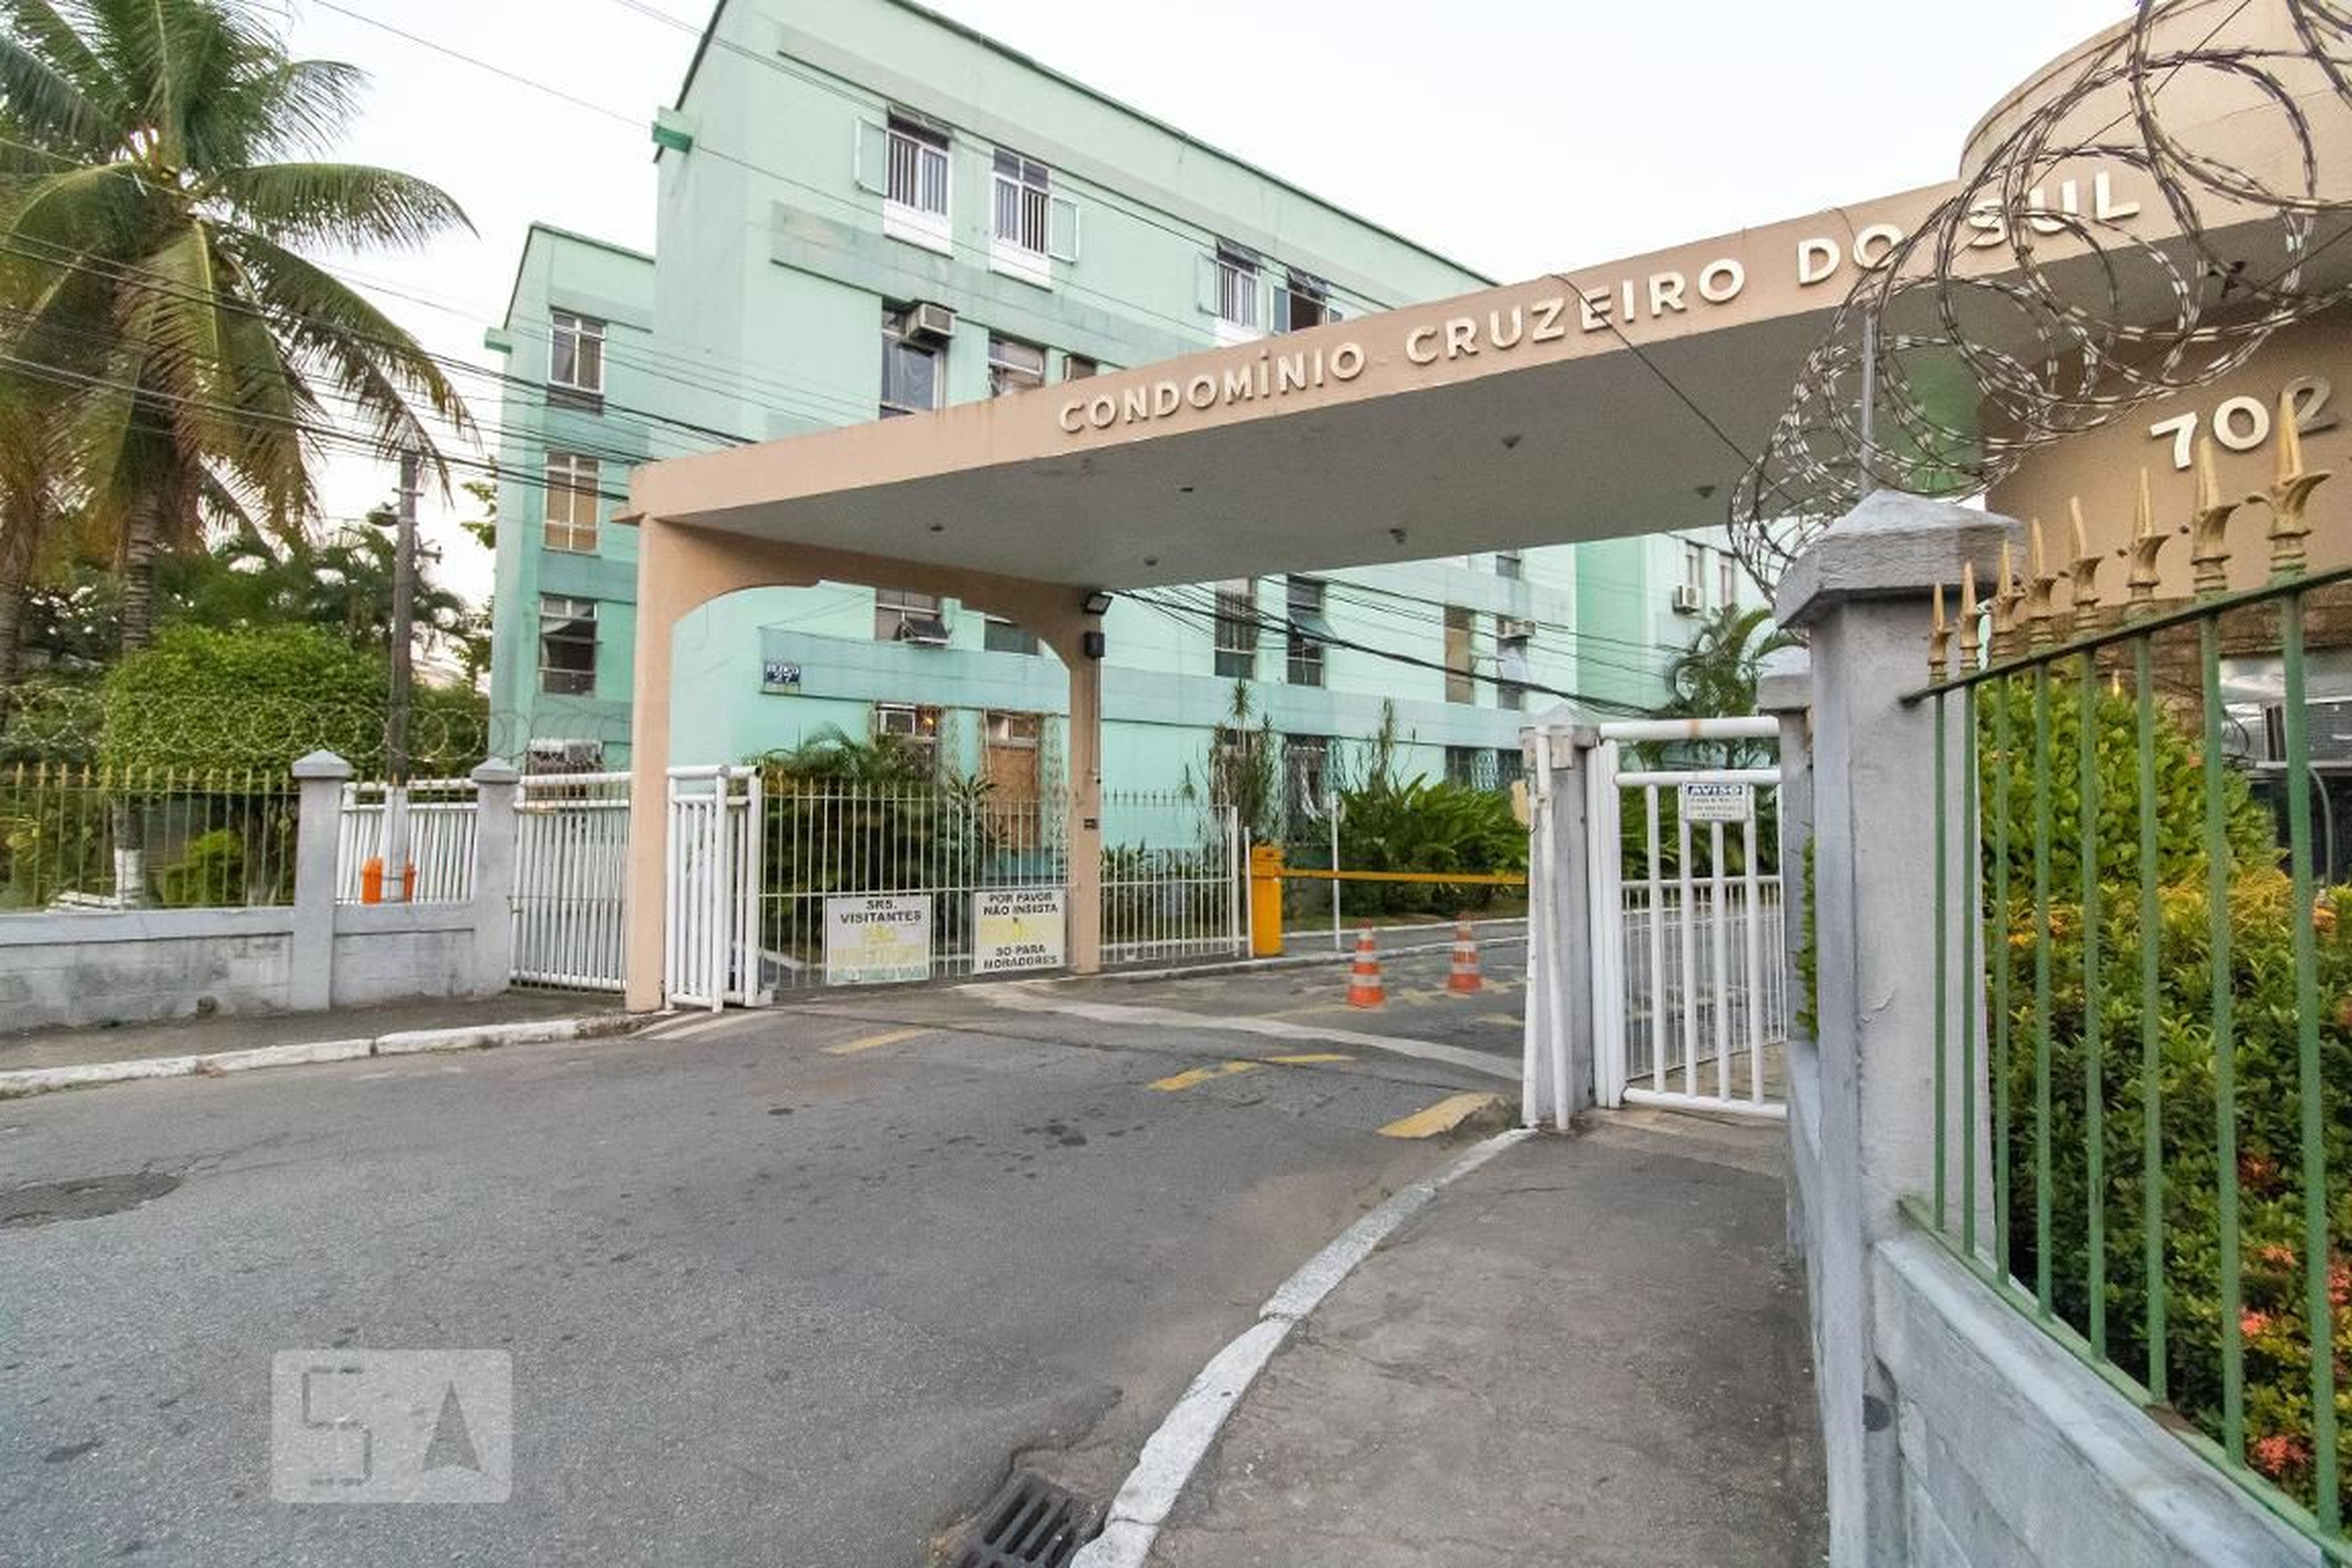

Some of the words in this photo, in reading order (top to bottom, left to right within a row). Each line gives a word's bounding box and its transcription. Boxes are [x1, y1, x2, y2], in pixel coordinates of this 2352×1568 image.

[1060, 342, 1365, 433] CONDOMÍNIO
[1406, 258, 1746, 364] CRUZEIRO
[1796, 223, 1905, 287] DO
[1968, 171, 2141, 247] SUL
[2150, 375, 2339, 469] 702
[1689, 785, 1741, 796] AVISO
[989, 894, 1013, 903] POR
[1016, 892, 1052, 902] FAVOR
[1012, 903, 1058, 914] INSISTA
[840, 910, 921, 924] VISITANTES
[1016, 944, 1046, 955] PARA
[983, 956, 1057, 970] MORADORES
